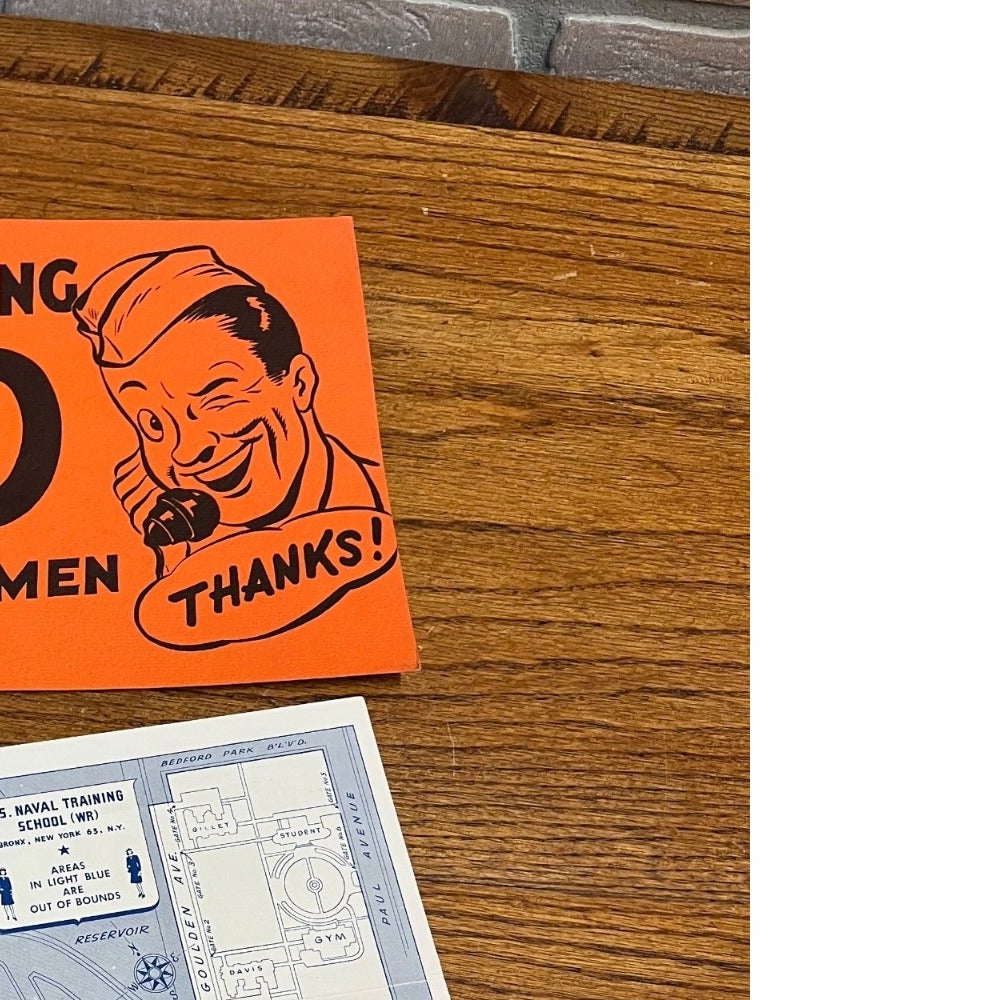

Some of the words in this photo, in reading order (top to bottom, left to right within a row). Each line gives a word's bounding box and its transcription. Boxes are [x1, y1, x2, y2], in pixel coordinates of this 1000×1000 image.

[168, 516, 385, 629] THANKS!
[161, 754, 212, 767] BEDFORD
[223, 748, 253, 757] PARK
[15, 800, 58, 816] NAVAL
[62, 790, 124, 809] TRAINING
[18, 815, 67, 832] SCHOOL
[71, 810, 99, 824] (WR)
[346, 792, 371, 859] AVENUE
[35, 835, 53, 843] NEW
[58, 830, 81, 839] YORK
[108, 824, 125, 832] N.Y.
[280, 827, 321, 839] STUDENT
[51, 862, 85, 875] AREAS
[169, 852, 184, 885] AVE.
[30, 881, 42, 889] IN
[48, 875, 78, 887] LIGHT
[85, 870, 111, 881] BLUE
[63, 886, 84, 896] ARE
[30, 902, 53, 914] OUT
[57, 900, 71, 909] OF
[76, 892, 121, 907] BOUNDS
[373, 883, 390, 925] PAUL
[75, 925, 149, 944] RESERVOIR
[315, 933, 346, 944] GYM
[181, 906, 211, 992] GOULDEN
[230, 965, 263, 975] DAVIS
